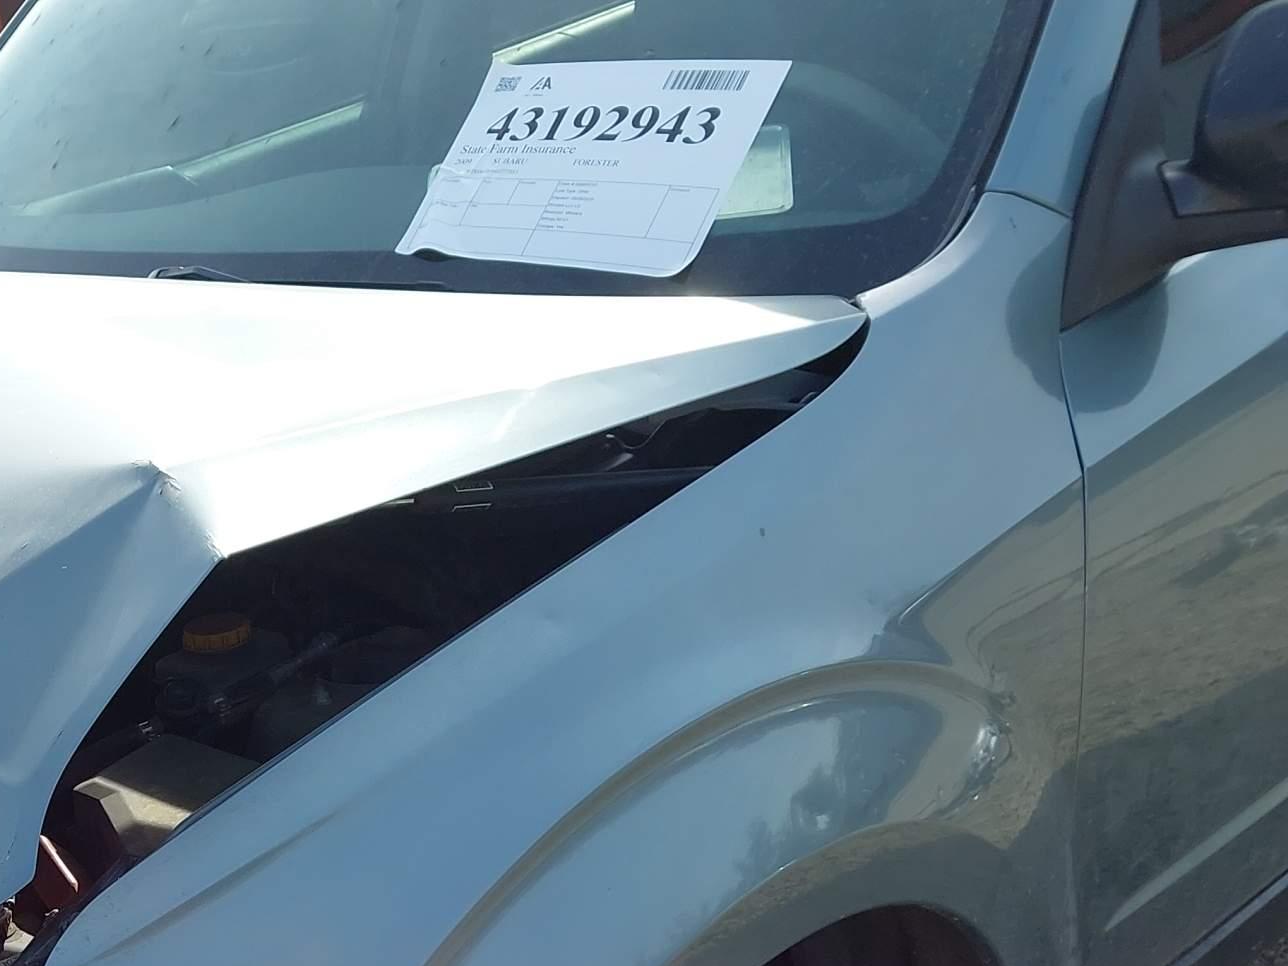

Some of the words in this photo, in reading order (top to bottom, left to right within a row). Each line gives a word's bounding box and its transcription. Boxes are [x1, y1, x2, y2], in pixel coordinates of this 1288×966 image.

[486, 105, 721, 144] 43192943
[460, 144, 487, 155] State
[488, 144, 519, 155] Farm
[520, 144, 577, 155] Insurance
[572, 158, 621, 167] FORESTER
